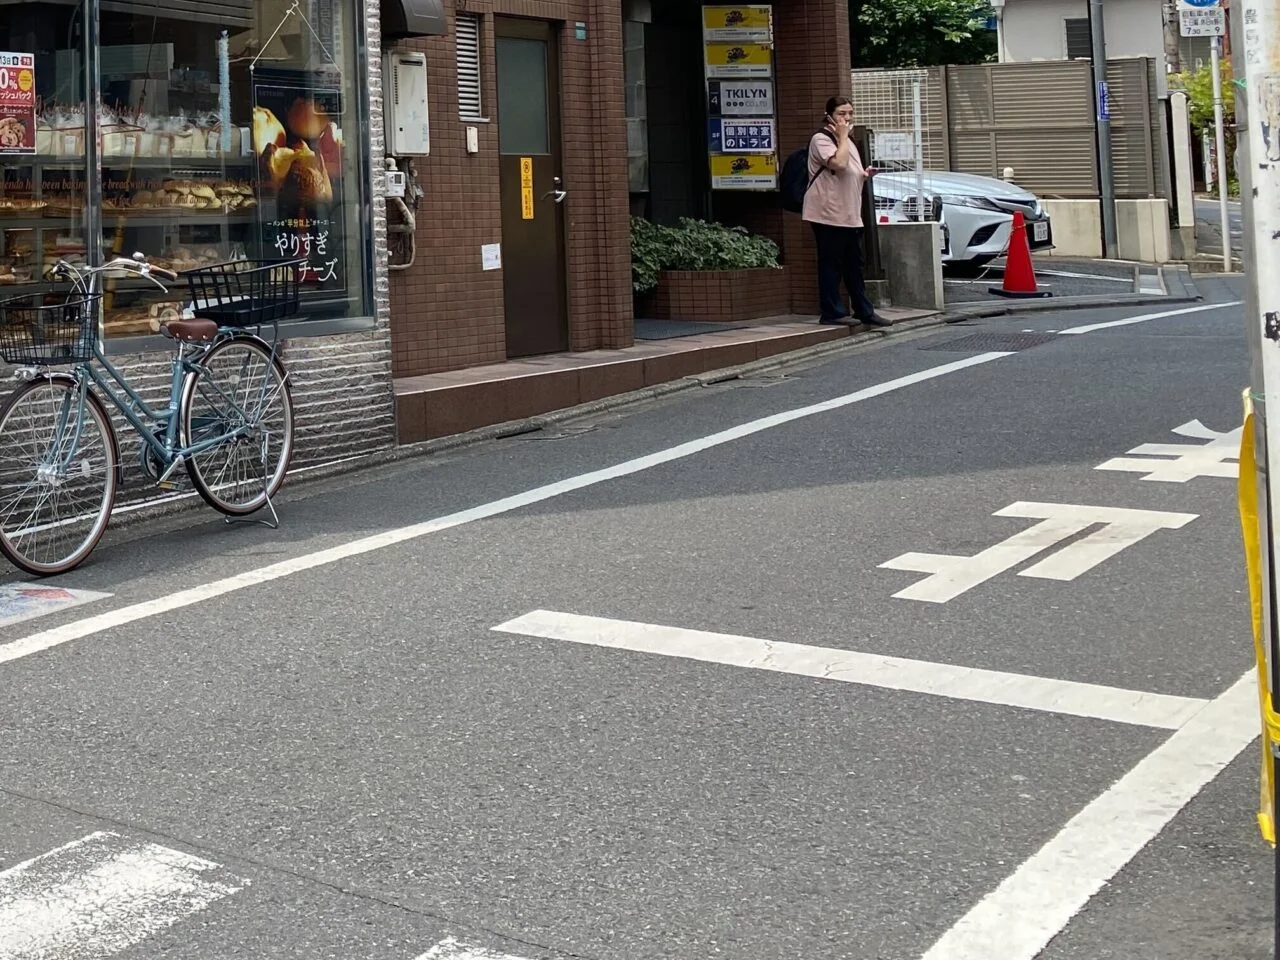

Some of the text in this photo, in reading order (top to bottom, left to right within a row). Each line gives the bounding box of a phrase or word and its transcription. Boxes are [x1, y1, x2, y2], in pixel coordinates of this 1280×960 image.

[726, 89, 767, 99] TKILYN
[725, 126, 770, 136] 個別教室
[726, 138, 770, 148] のトライ
[62, 178, 87, 190] bakin
[275, 230, 329, 256] やりすぎ
[298, 257, 338, 282] チーズ
